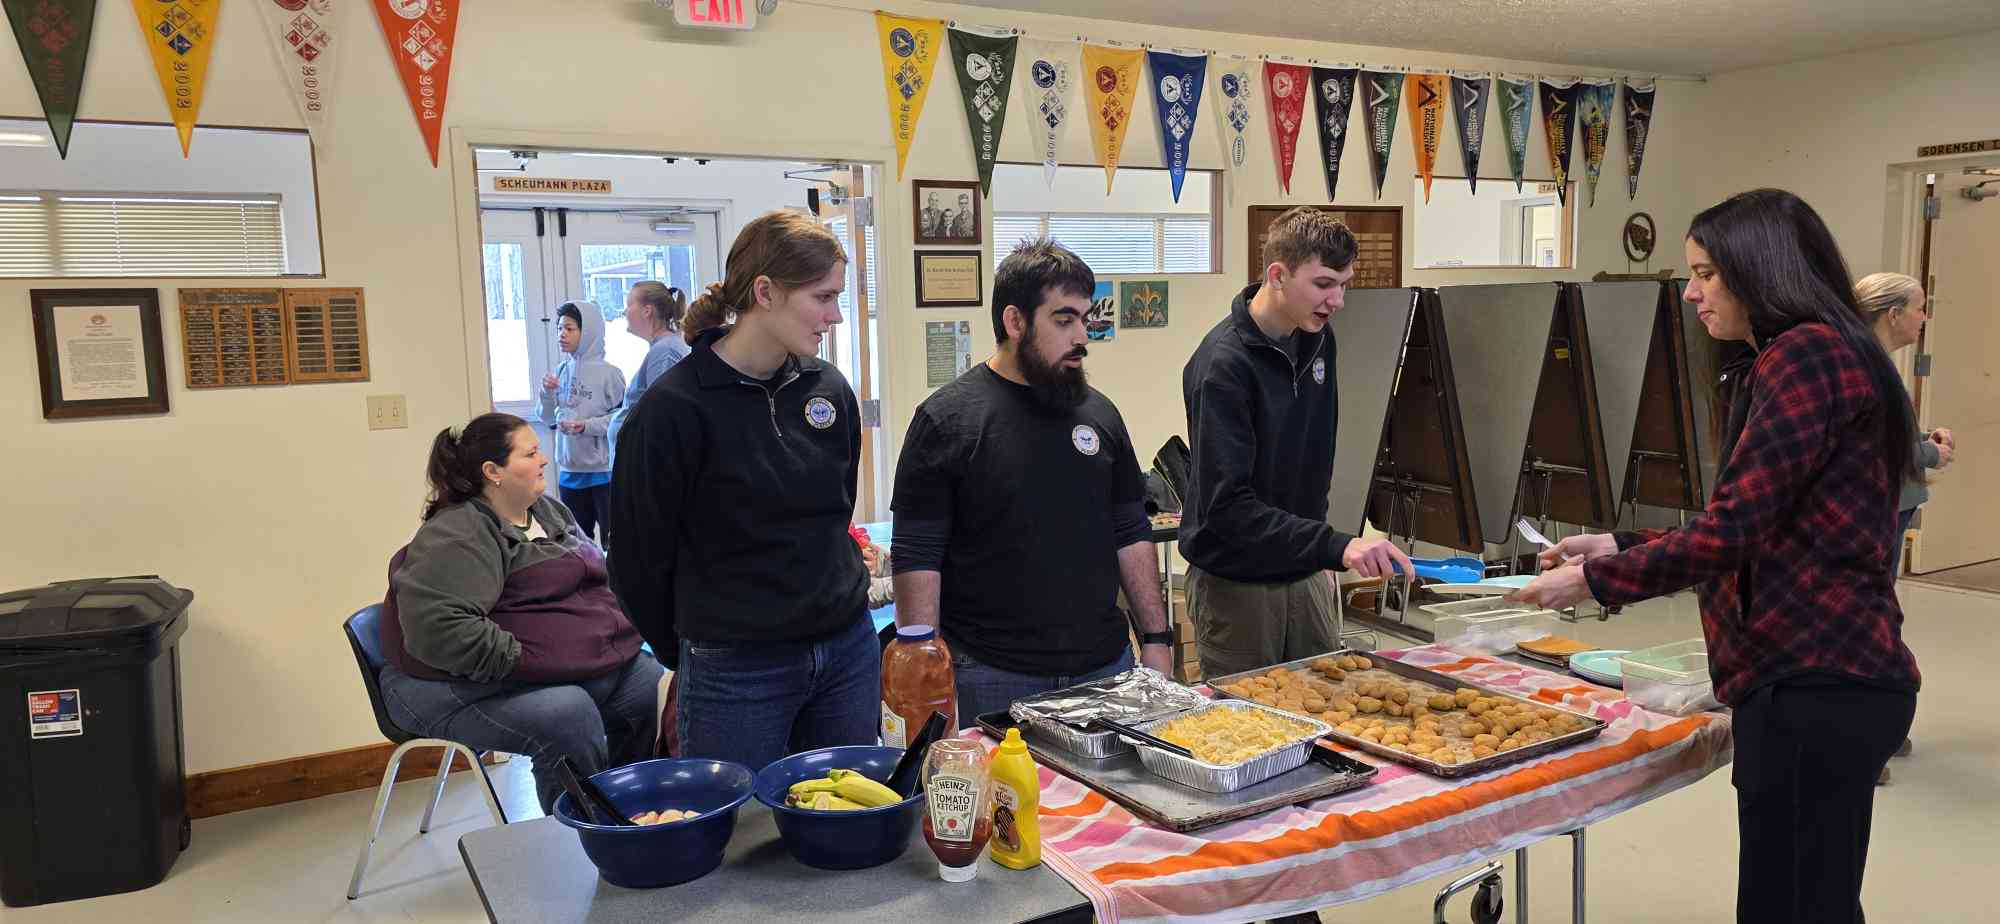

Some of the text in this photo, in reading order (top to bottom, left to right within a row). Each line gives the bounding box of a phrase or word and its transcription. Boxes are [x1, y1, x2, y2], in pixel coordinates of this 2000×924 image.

[420, 74, 438, 120] 2004
[1921, 142, 1985, 156] SORENSEN
[500, 178, 609, 191] SCHEUMANN PLAZA
[939, 781, 965, 792] HEINZ
[936, 793, 970, 805] TOMATO
